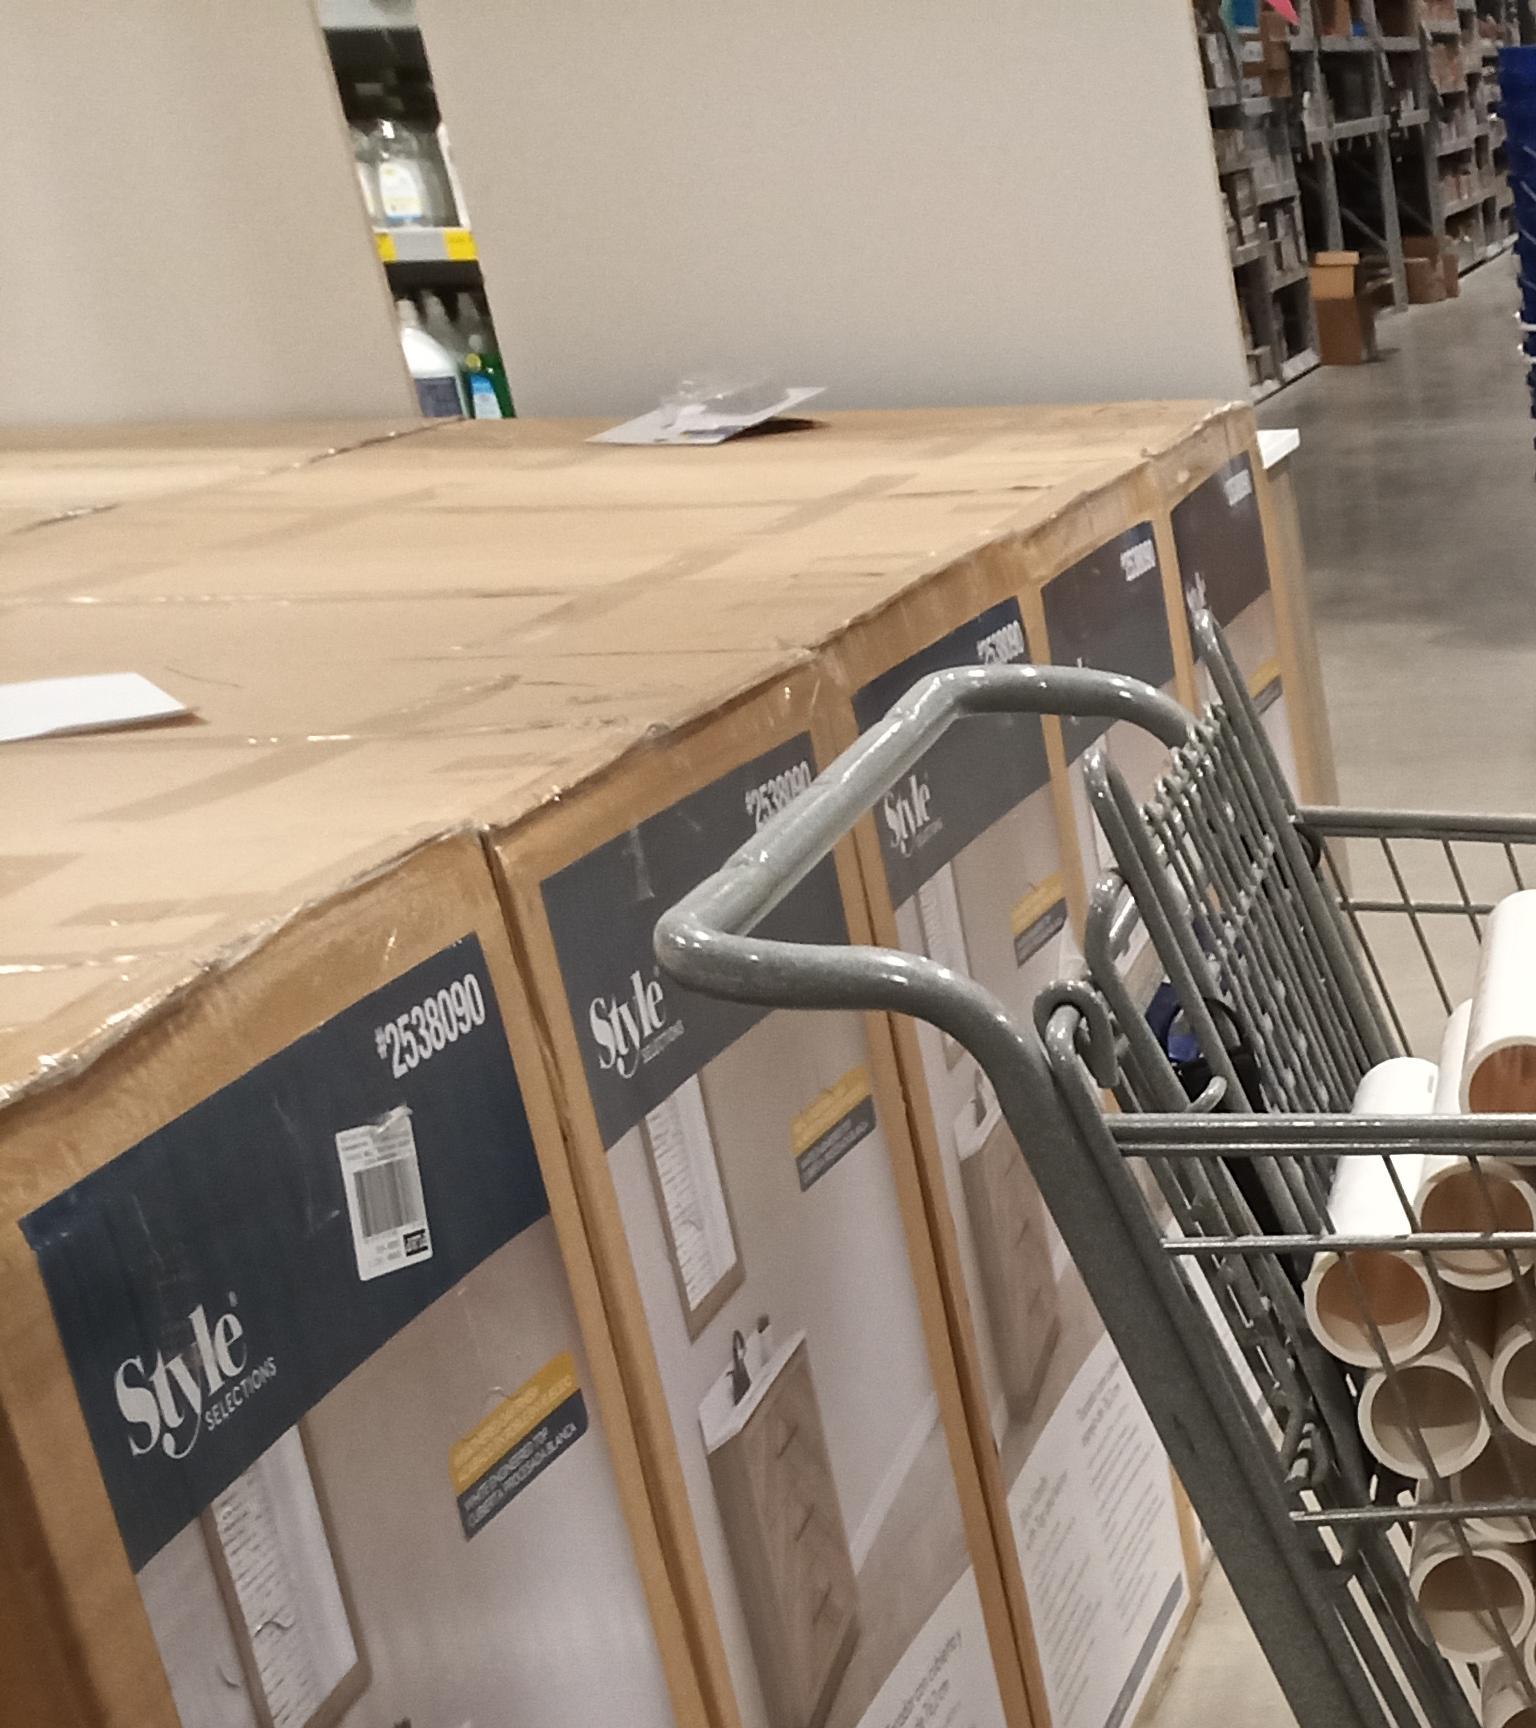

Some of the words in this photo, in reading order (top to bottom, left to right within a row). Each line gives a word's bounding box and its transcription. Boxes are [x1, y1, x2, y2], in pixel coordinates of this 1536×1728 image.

[374, 973, 486, 1079] #2538090
[589, 970, 666, 1080] Style
[114, 1303, 247, 1459] Style
[204, 1356, 277, 1431] SELECTIONS
